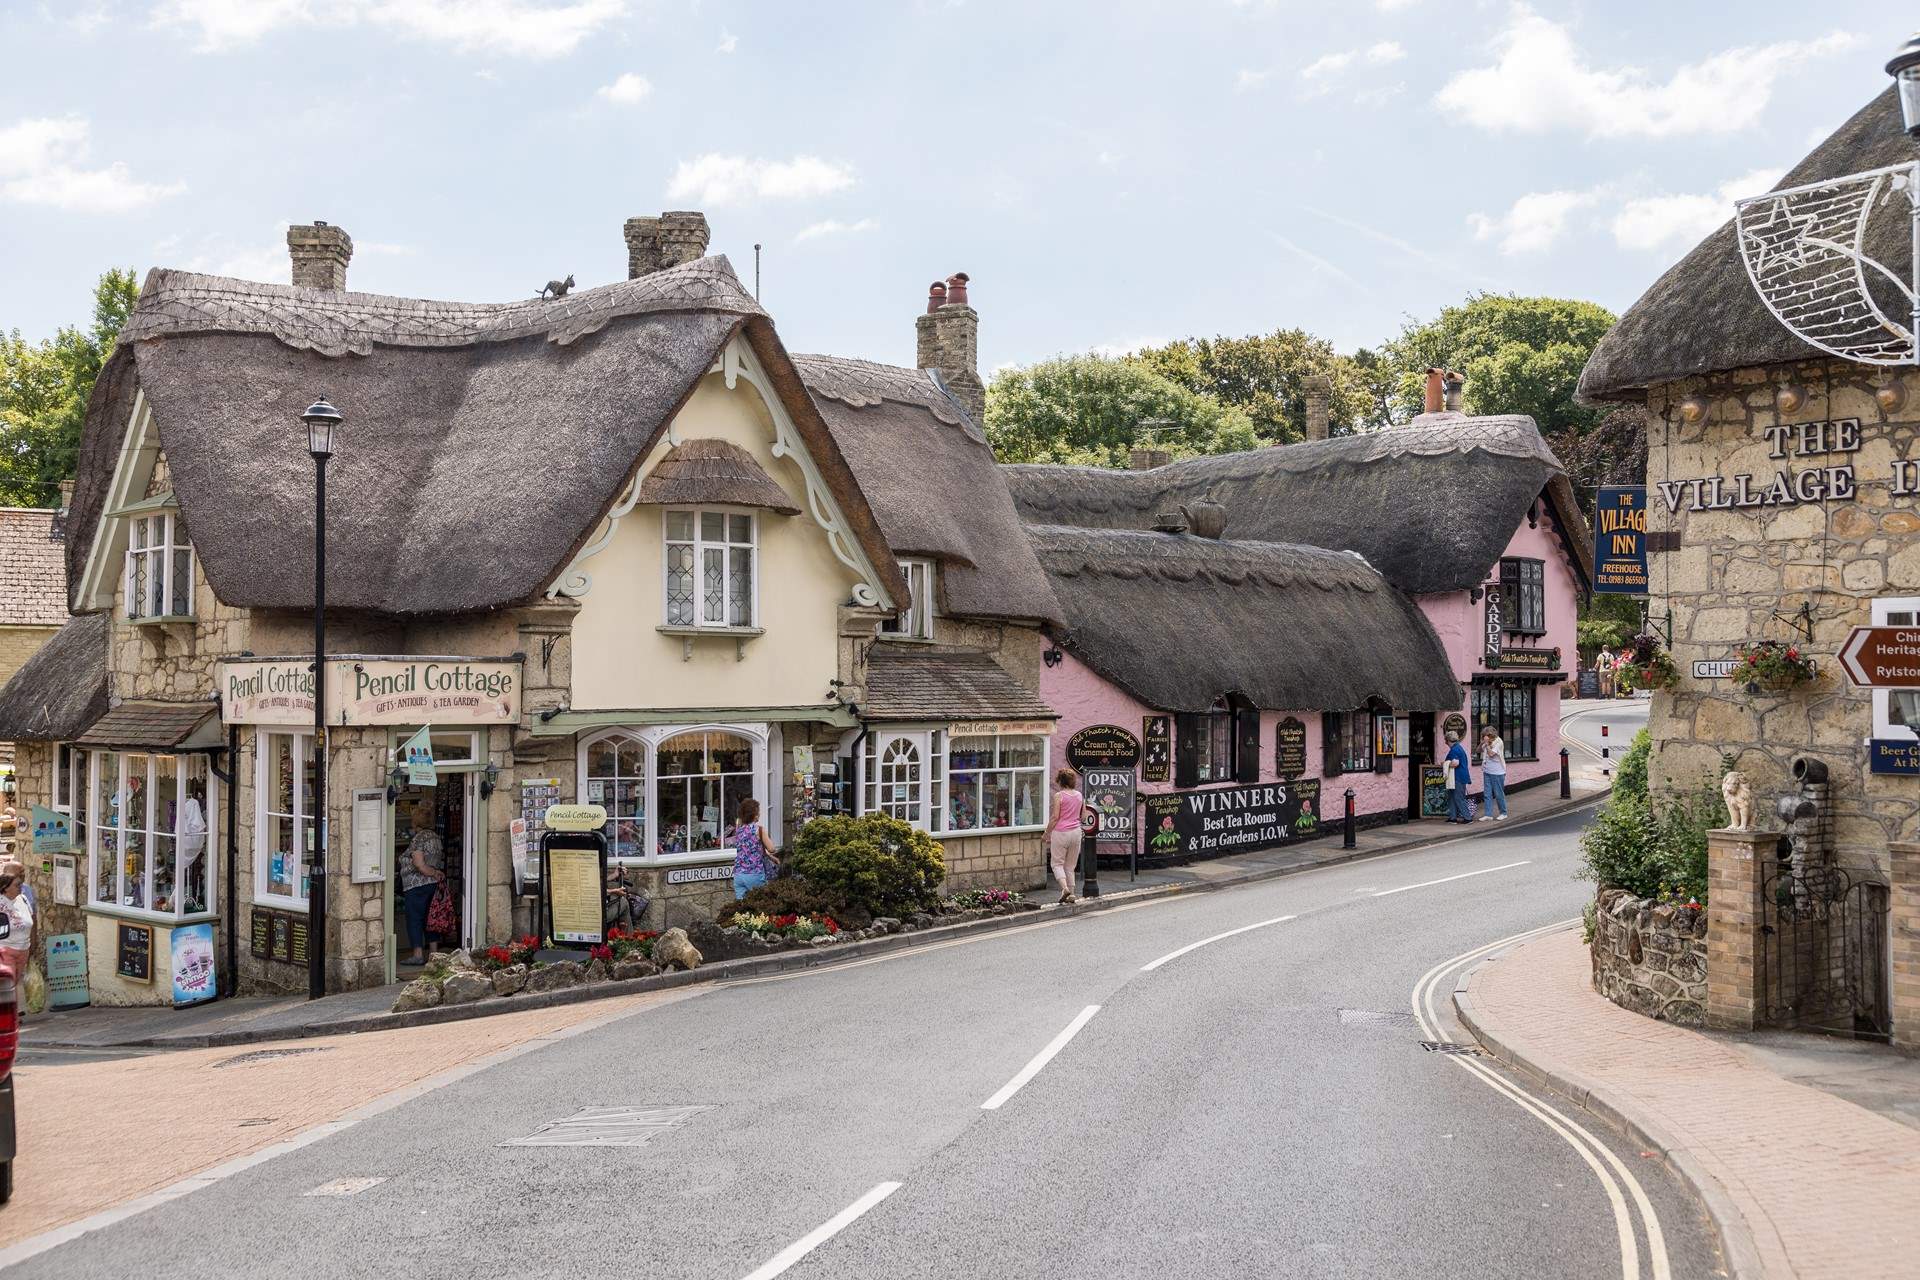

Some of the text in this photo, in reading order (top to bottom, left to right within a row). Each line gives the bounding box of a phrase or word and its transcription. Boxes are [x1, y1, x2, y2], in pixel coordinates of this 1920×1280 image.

[1764, 418, 1861, 459] THE
[1657, 465, 1855, 512] VILLAGE
[1619, 494, 1633, 506] THE
[1612, 534, 1636, 555] INN
[1602, 564, 1643, 574] FREEHOUSE
[1625, 575, 1647, 585] 865500
[1486, 593, 1501, 654] GARDEN
[1896, 631, 1920, 642] Chi
[1876, 666, 1920, 678] Rylsto
[230, 666, 315, 702] Pencil Cottag
[356, 664, 512, 700] Pencil Cottage
[434, 699, 438, 709] &
[440, 697, 452, 708] TEA
[454, 697, 480, 707] GARDEN
[954, 722, 972, 734] Pencil
[975, 721, 999, 735] Cottage
[1073, 726, 1137, 747] Old Thatch Teashop
[1084, 740, 1125, 748] Cream Teas
[1880, 745, 1906, 755] Beer
[1074, 748, 1134, 756] Homemade Food
[1894, 757, 1906, 767] At
[1088, 773, 1130, 786] OPEN
[1149, 797, 1163, 807] Old
[1164, 795, 1183, 805] Thatch
[1188, 786, 1287, 814] WINNERS
[550, 811, 602, 821] Pencil Cottage
[1155, 806, 1179, 815] Teashop
[1203, 812, 1277, 832] Best Tea Rooms
[1188, 836, 1199, 851] &
[1200, 834, 1217, 849] Tea
[1219, 829, 1259, 846] Gardens
[1260, 824, 1289, 841] I.O.W.
[672, 868, 713, 882] CHURCH
